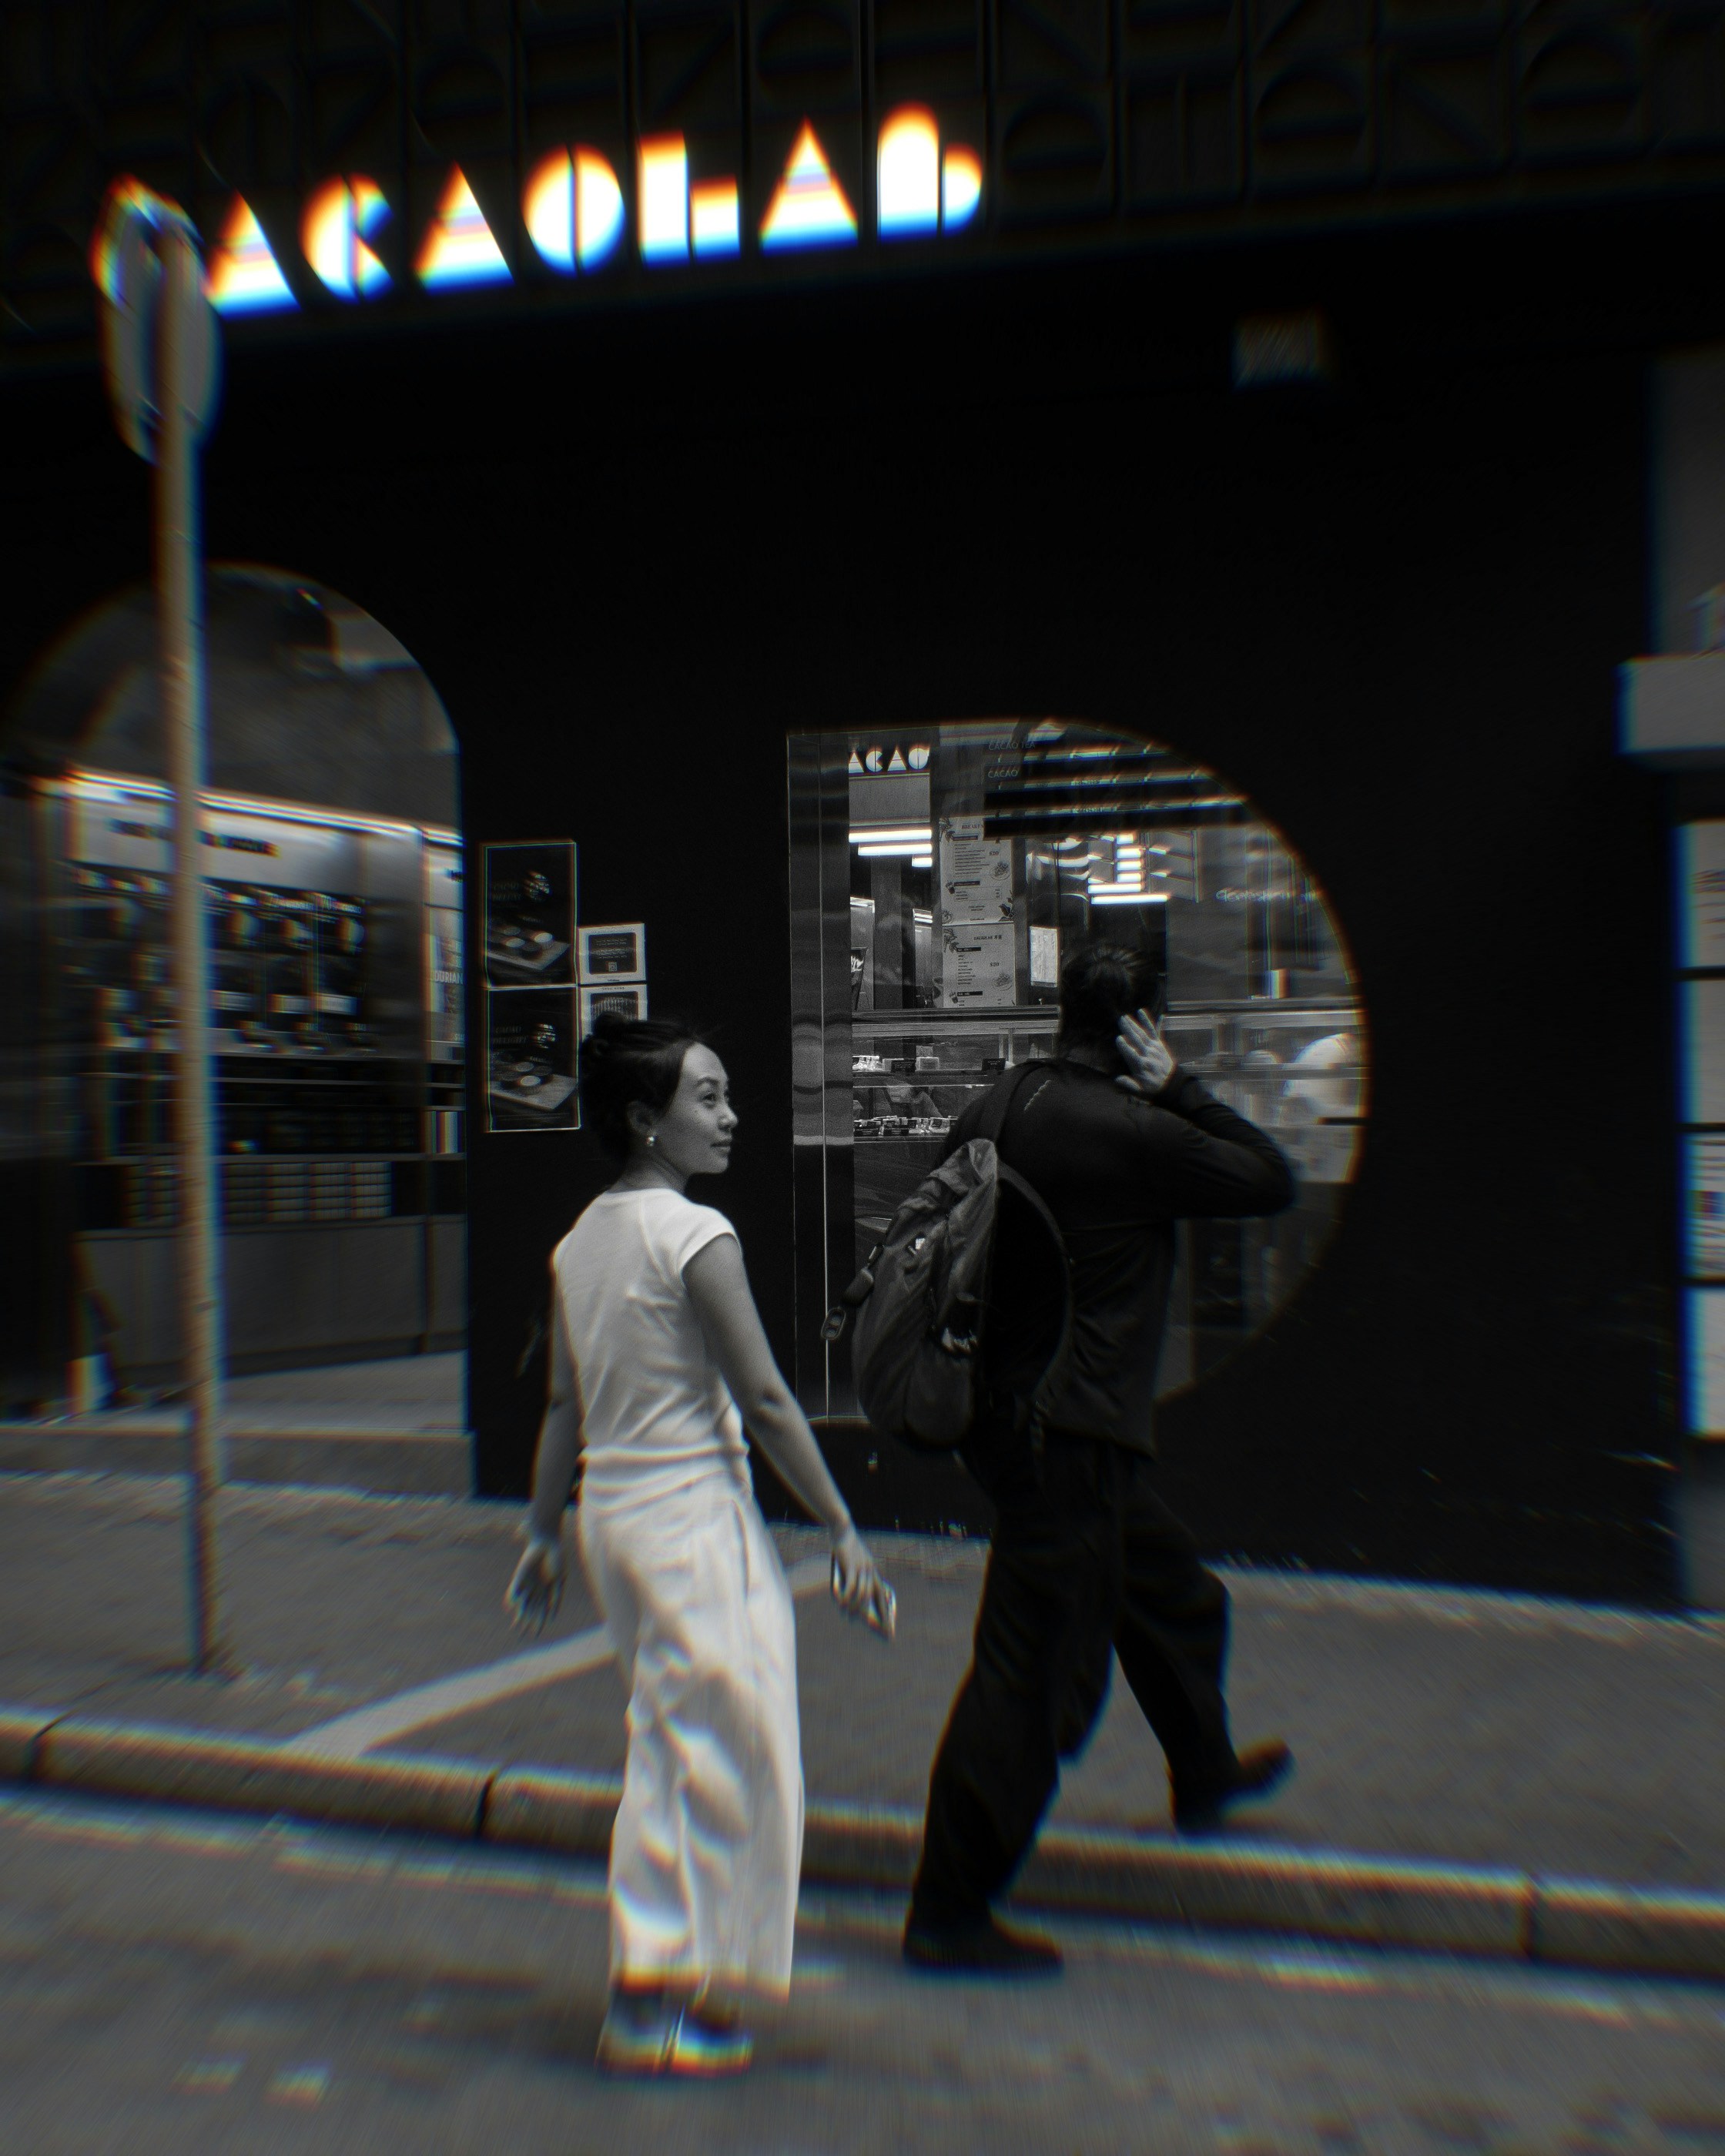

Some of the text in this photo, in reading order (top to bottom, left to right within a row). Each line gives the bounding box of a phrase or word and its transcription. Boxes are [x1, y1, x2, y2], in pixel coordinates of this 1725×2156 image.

[989, 740, 1036, 751] CACAO TEA
[988, 769, 1018, 778] CACAO
[434, 971, 464, 985] DURIAN
